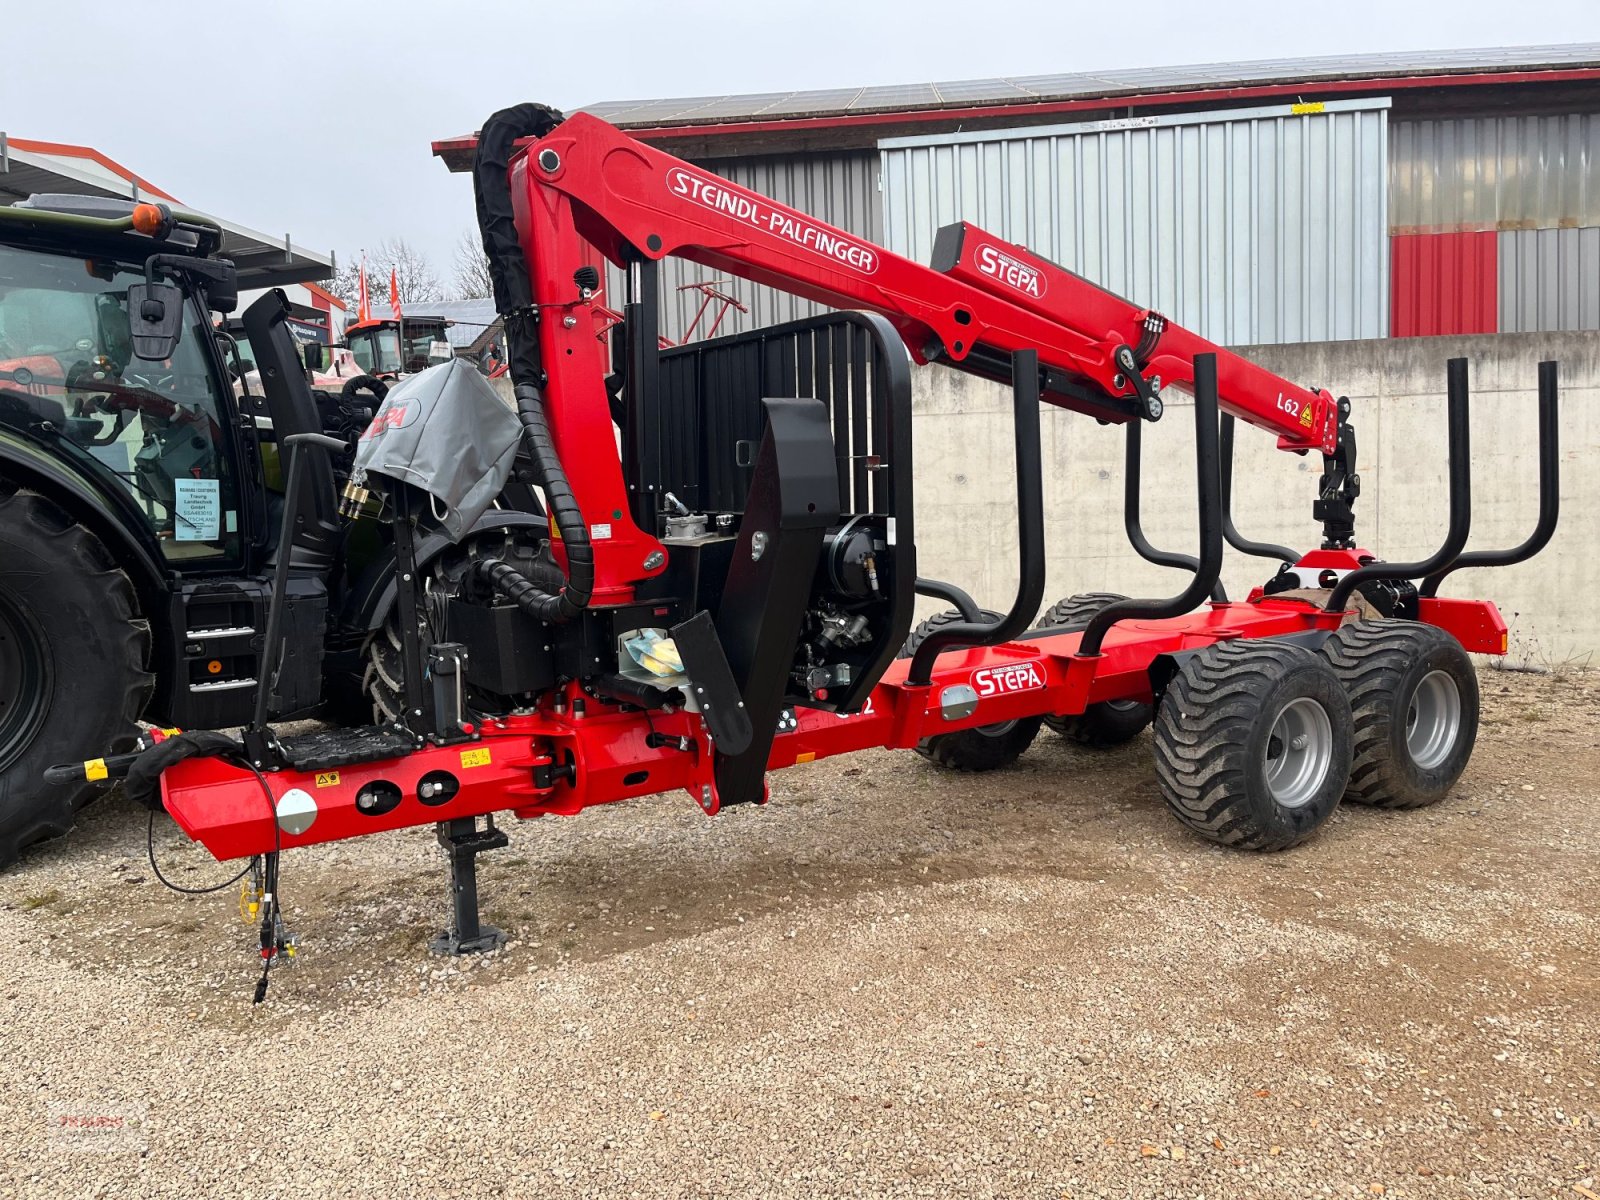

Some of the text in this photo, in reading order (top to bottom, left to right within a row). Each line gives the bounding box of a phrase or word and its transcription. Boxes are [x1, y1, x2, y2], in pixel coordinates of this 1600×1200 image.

[674, 172, 873, 271] STEINDL-PALFINGER
[980, 247, 1039, 297] STEPA
[1276, 392, 1299, 417] L62
[976, 669, 1042, 696] STEPA
